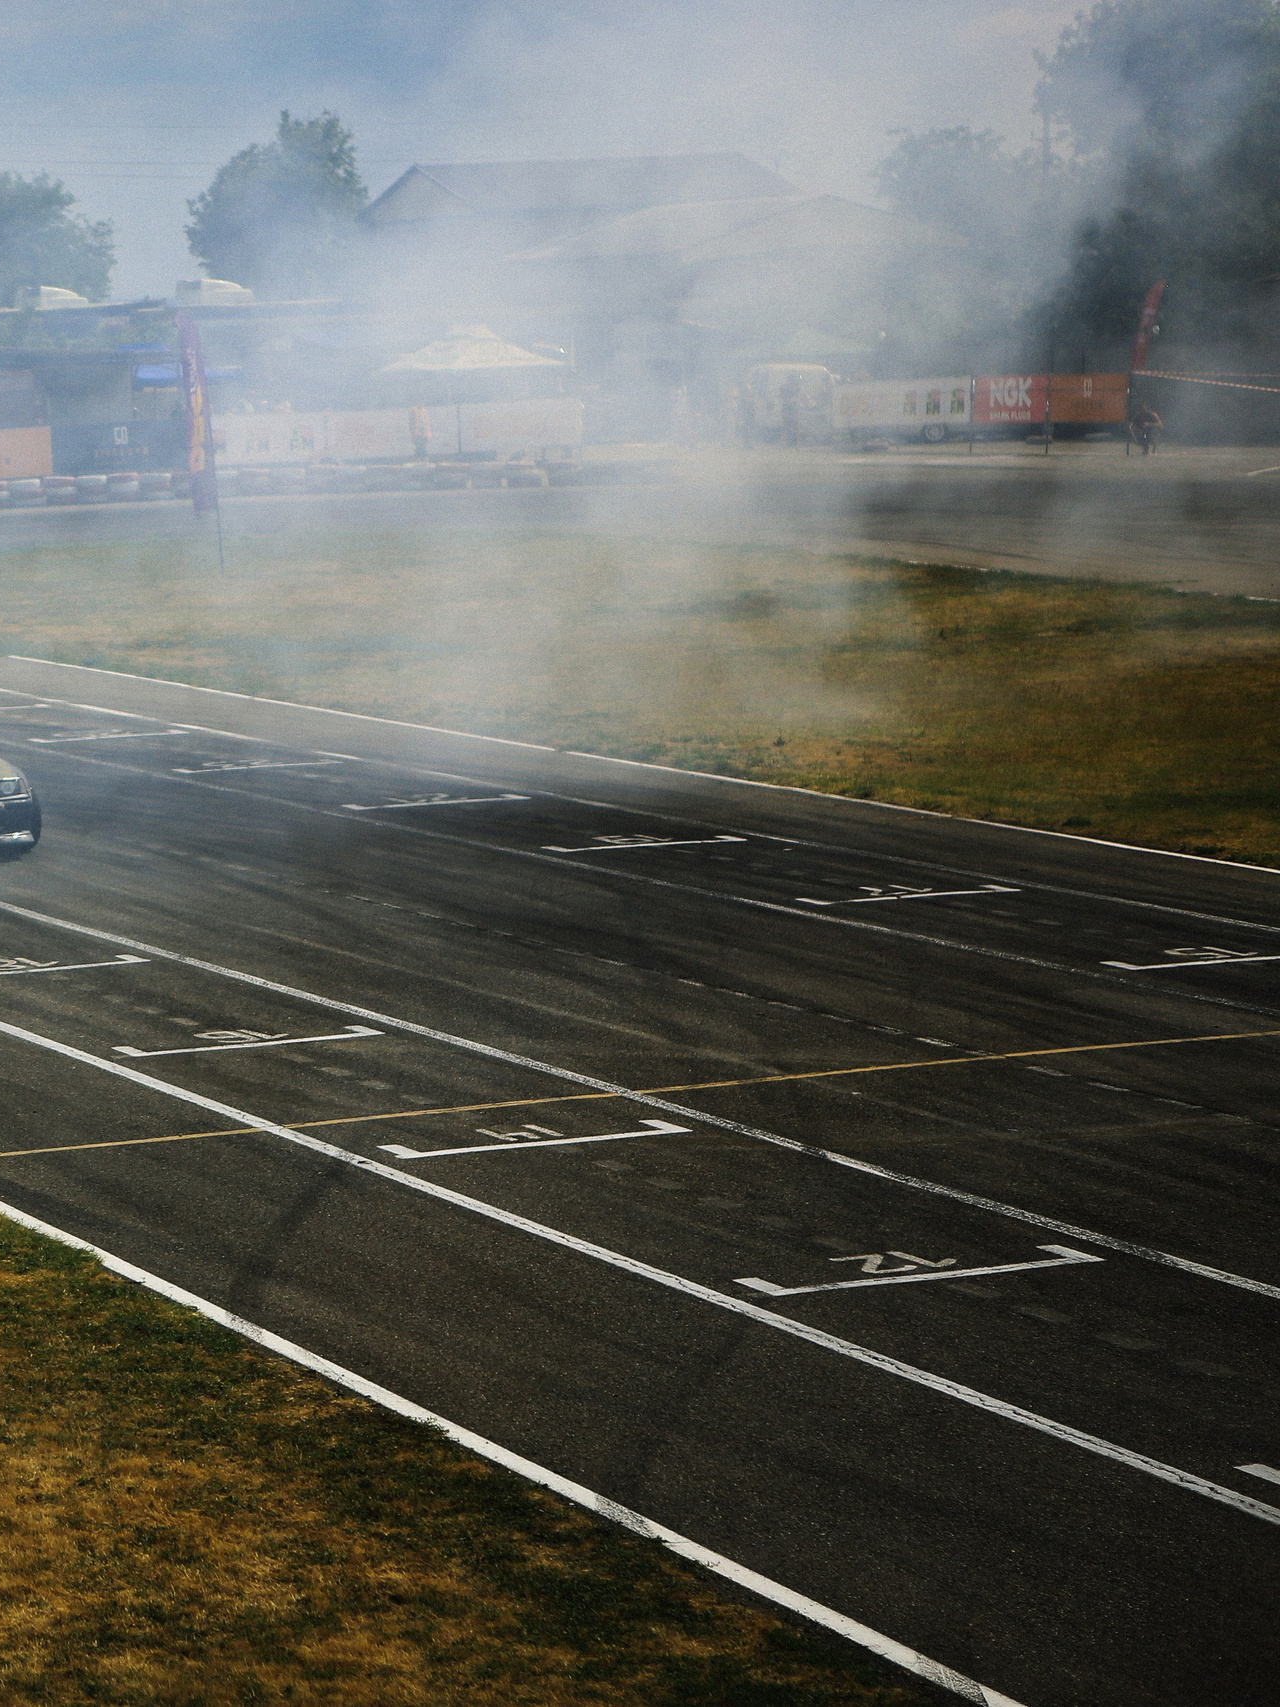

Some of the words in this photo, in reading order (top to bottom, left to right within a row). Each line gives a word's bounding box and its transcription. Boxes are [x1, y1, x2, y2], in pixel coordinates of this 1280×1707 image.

[988, 377, 1032, 408] NGK
[1011, 410, 1031, 421] PLUGS
[858, 883, 934, 897] 17
[1163, 945, 1259, 960] 15
[193, 1027, 289, 1044] 16
[828, 1251, 958, 1275] 12
